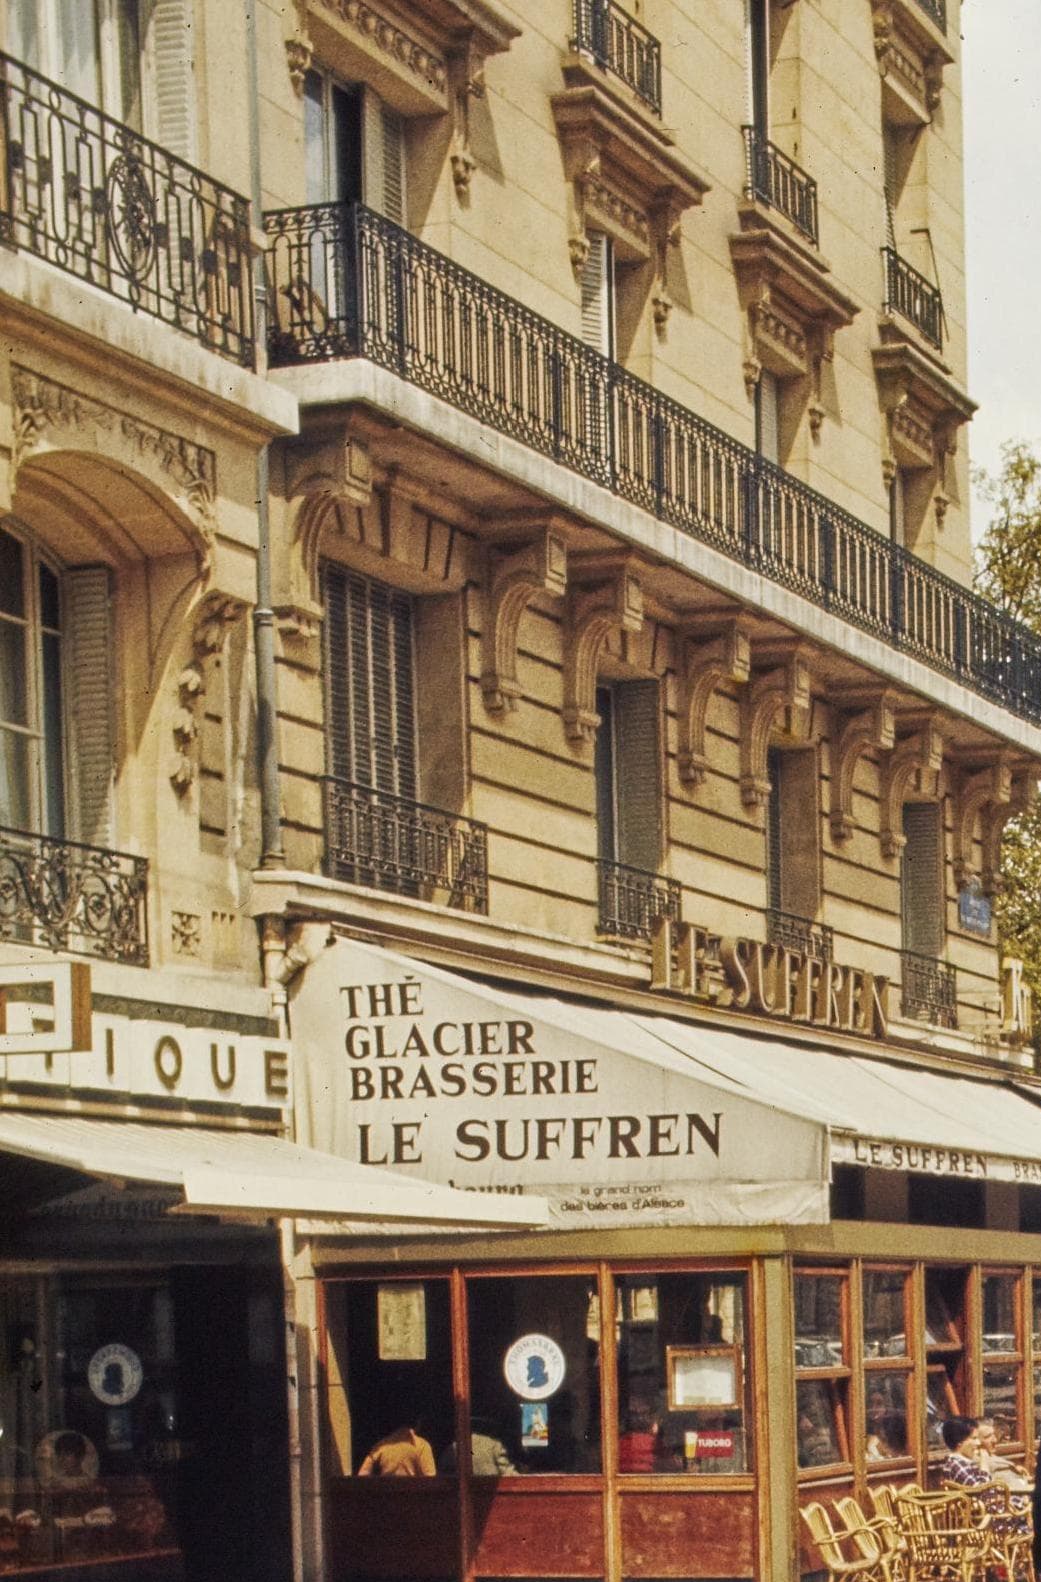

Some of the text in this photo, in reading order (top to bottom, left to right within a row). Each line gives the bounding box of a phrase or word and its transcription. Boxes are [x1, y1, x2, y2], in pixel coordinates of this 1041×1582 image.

[345, 1019, 536, 1060] GLACIER
[349, 1058, 600, 1102] BRASSERIE
[357, 1111, 723, 1166] LE SUFFREN
[854, 1142, 882, 1165] LE
[892, 1144, 988, 1176] SUFFREN
[593, 1184, 631, 1197] grand
